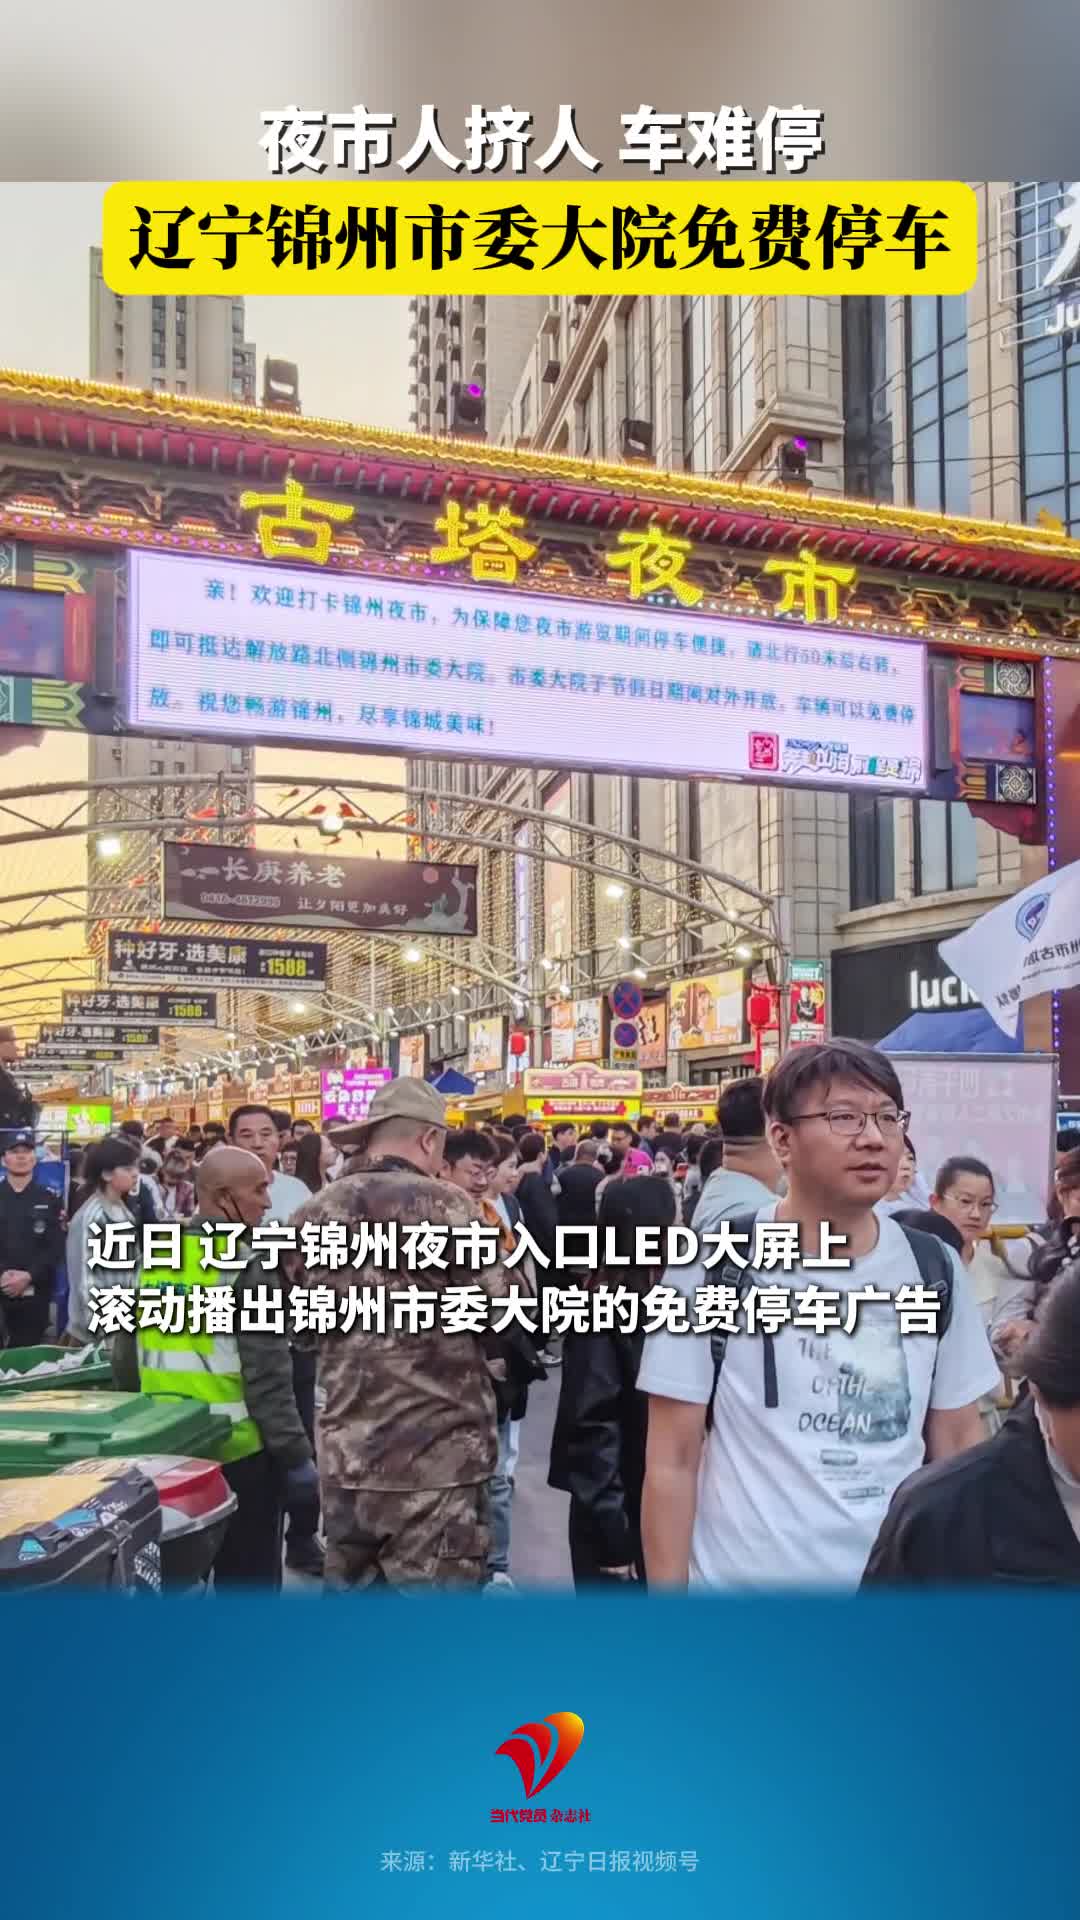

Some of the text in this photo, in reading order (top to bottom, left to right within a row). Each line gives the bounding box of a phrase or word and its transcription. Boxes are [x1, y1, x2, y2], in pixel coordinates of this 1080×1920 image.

[240, 478, 856, 625] 古塔夜市
[798, 1410, 872, 1434] OCEAN
